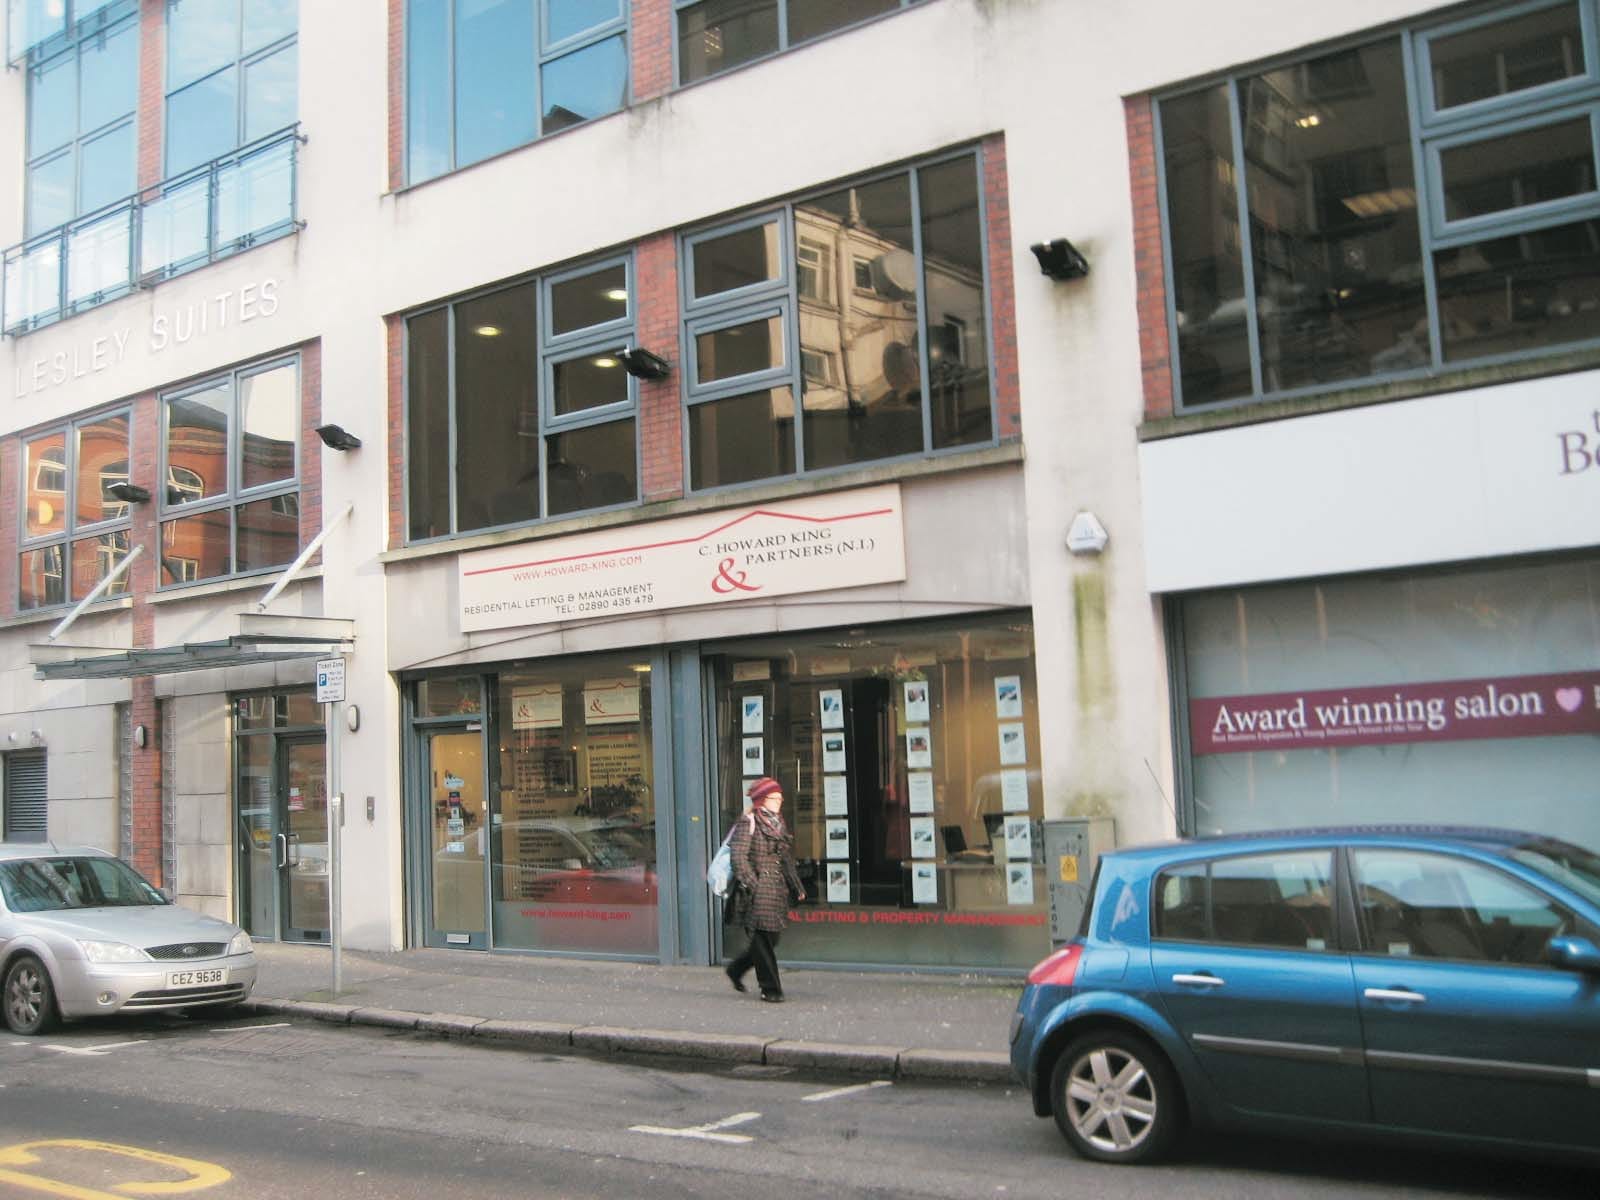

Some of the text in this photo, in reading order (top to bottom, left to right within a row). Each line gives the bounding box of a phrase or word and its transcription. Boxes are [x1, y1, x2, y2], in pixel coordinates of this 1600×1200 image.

[15, 278, 281, 399] LESLEY SUITES
[1556, 430, 1600, 476] B
[717, 534, 786, 554] HOWARD
[791, 527, 832, 545] KING
[513, 555, 642, 582] WWW.HOWARD-KING.COM
[711, 538, 875, 593] & PARTNERS (N.I.)
[464, 600, 522, 616] RESIDENTIAL
[525, 593, 566, 609] LETTING
[578, 583, 653, 599] MANAGEMENT
[555, 593, 654, 615] TEL: 02890 435 479
[1213, 684, 1543, 733] Award winning salon
[805, 912, 854, 923] LETTING
[872, 912, 938, 925] PROPERTY
[172, 970, 222, 985] CEZ 9638
